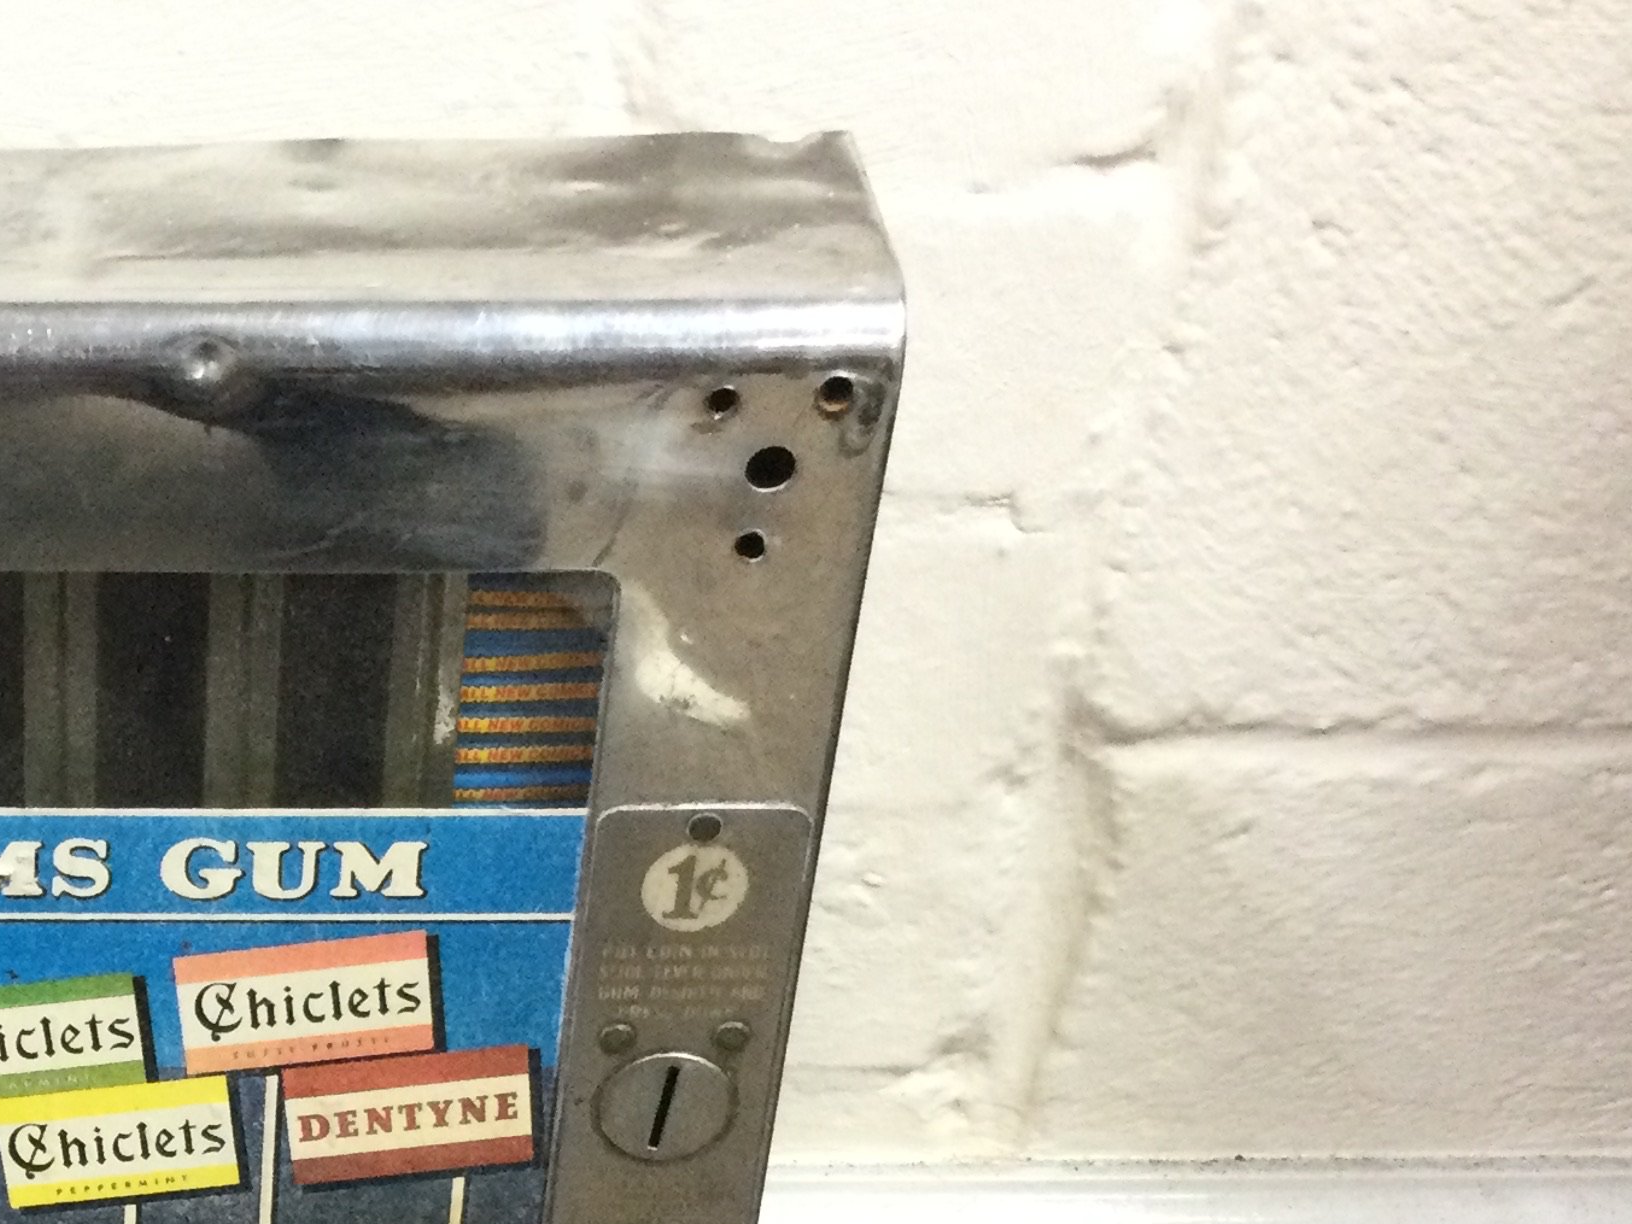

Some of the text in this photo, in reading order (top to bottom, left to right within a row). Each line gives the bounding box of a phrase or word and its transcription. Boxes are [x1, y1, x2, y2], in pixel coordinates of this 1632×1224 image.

[159, 836, 429, 900] GUM
[662, 854, 729, 920] 1¢
[193, 976, 422, 1042] Chiclets
[297, 1091, 520, 1143] DENTYNE
[7, 1118, 227, 1181] Chiclets
